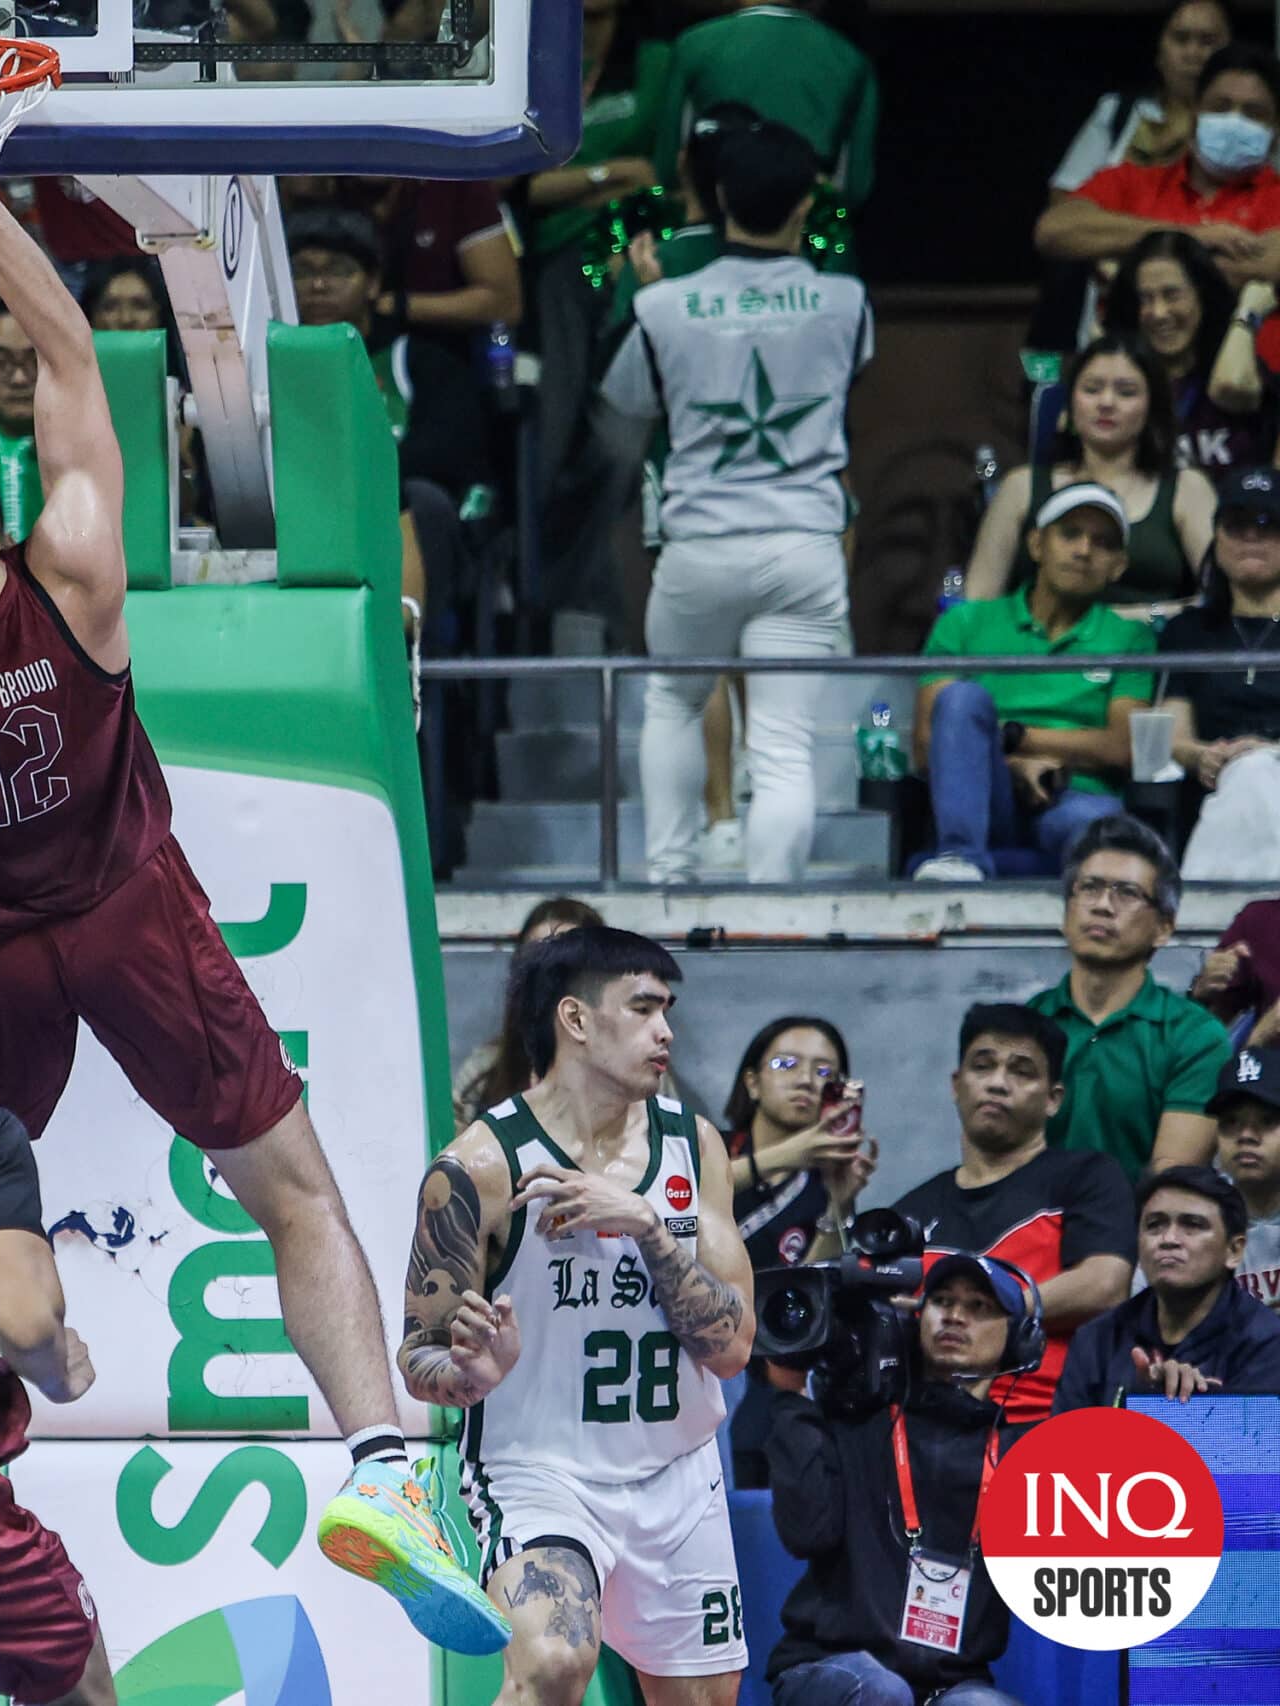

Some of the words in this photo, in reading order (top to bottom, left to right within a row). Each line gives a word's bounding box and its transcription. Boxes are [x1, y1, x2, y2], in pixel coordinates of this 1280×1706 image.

[685, 288, 724, 319] La
[1236, 1050, 1261, 1082] LA
[548, 1256, 600, 1312] La
[582, 1329, 681, 1424] 28
